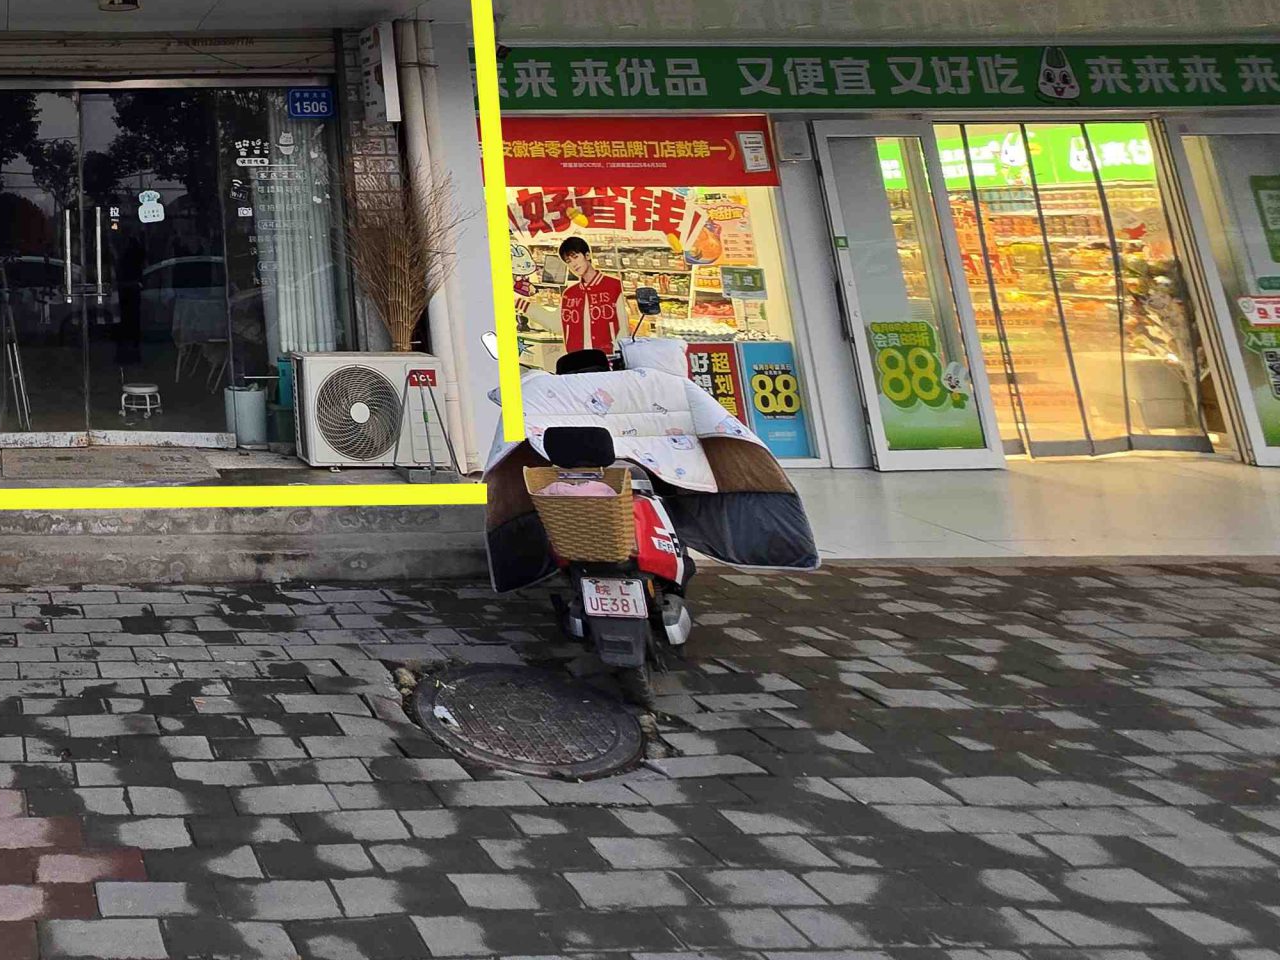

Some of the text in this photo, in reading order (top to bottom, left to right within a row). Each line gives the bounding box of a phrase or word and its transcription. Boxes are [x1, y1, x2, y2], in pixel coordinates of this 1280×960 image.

[570, 58, 708, 97] 来优品
[737, 56, 875, 97] 又便宜
[888, 55, 1024, 97] 又好吃
[1085, 55, 1227, 94] 来来来
[295, 101, 328, 113] 1506
[109, 206, 120, 217] 拉
[595, 584, 612, 596] 皖
[589, 596, 639, 614] UE381
